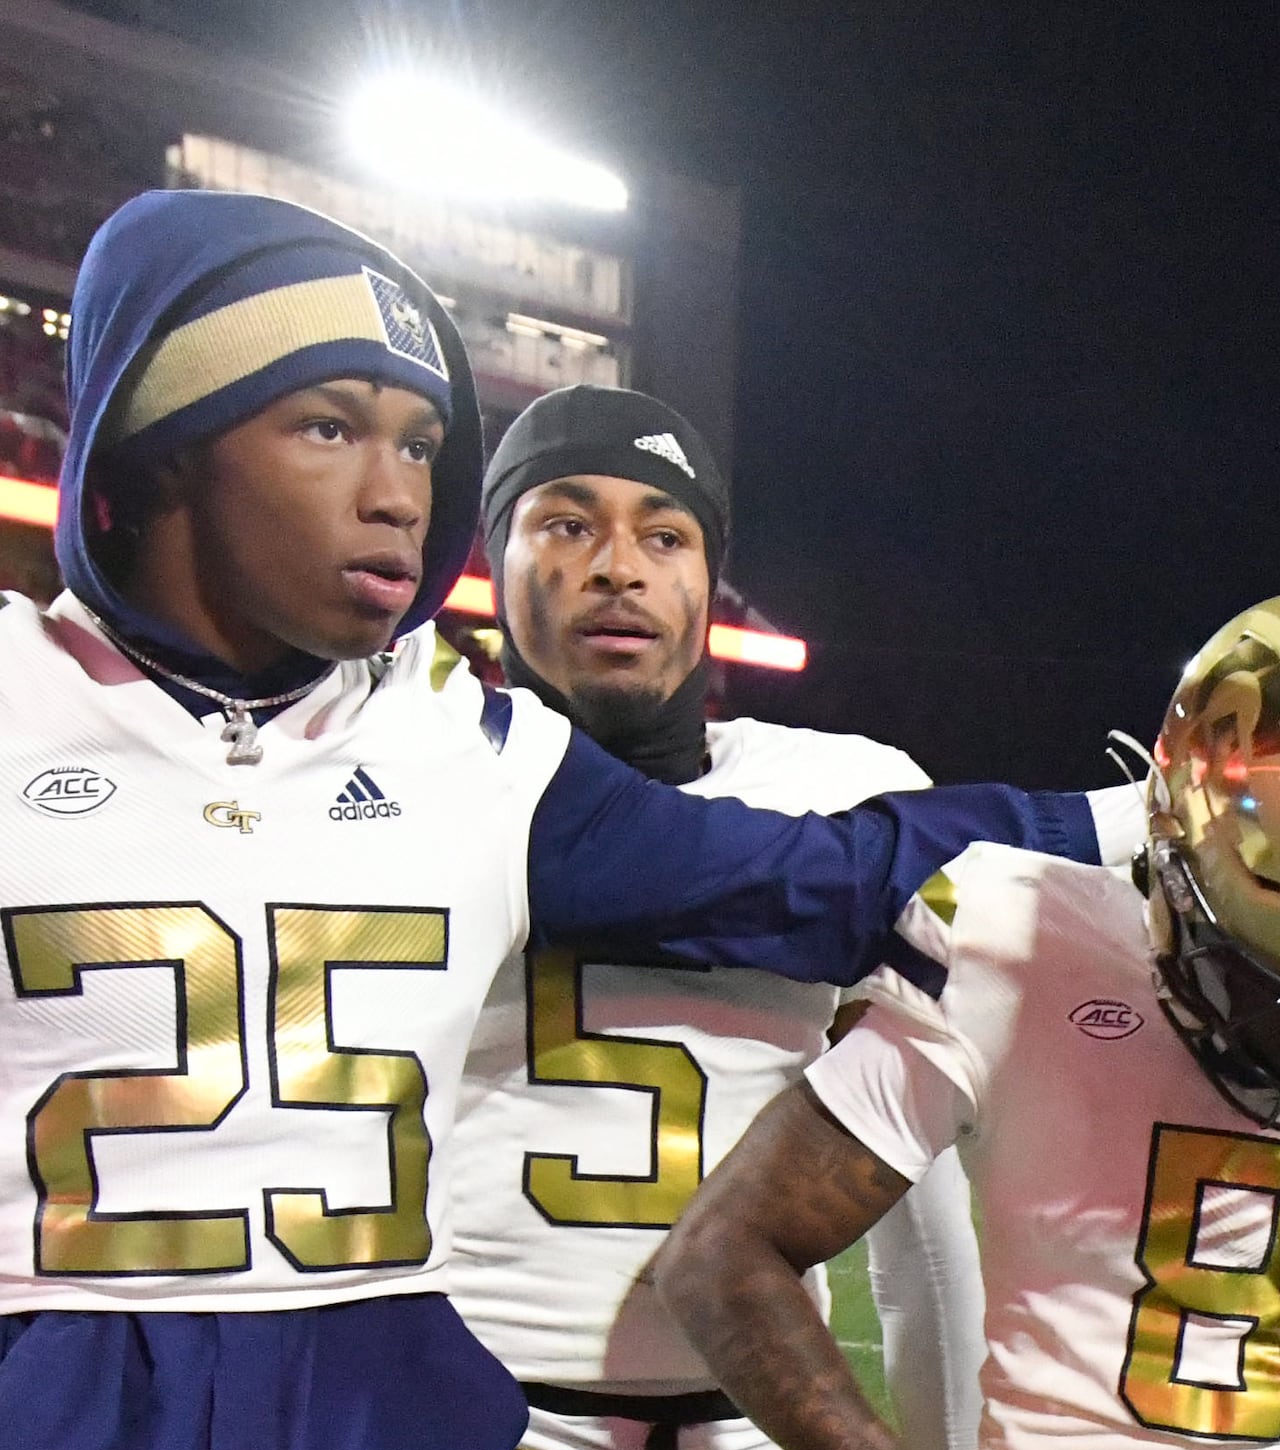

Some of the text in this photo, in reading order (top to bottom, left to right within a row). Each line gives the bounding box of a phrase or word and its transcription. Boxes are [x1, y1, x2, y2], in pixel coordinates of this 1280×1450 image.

[40, 777, 101, 797] ACC
[203, 800, 261, 833] GT
[328, 799, 402, 821] adidas
[1079, 1009, 1131, 1025] ACC
[0, 900, 450, 1276] 25
[523, 950, 710, 1230] 5
